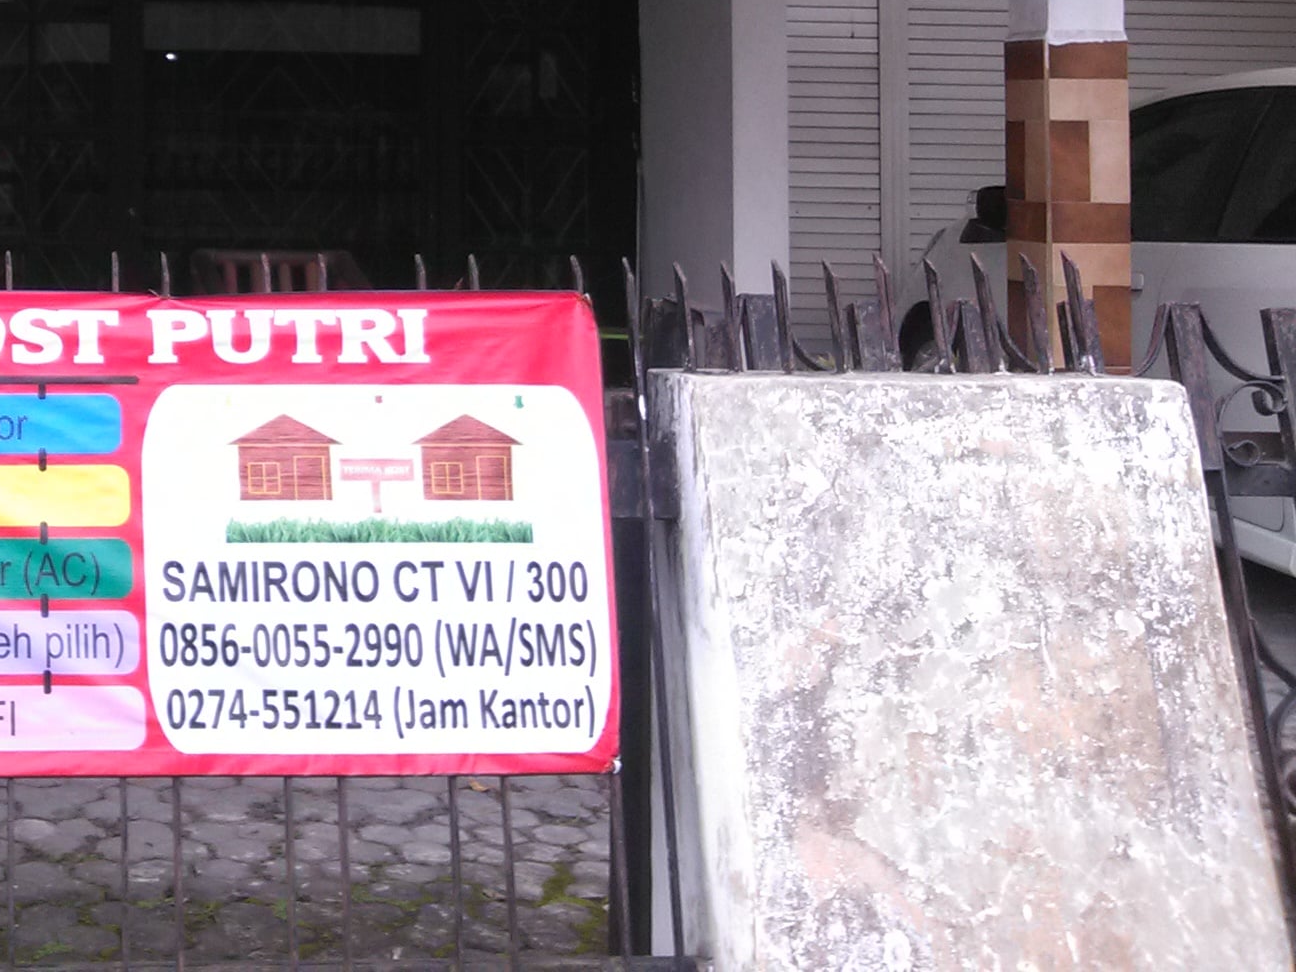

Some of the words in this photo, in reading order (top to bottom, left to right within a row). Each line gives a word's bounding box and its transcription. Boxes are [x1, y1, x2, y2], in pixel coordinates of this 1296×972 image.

[147, 308, 431, 365] PUTRI
[23, 552, 101, 596] (AC)
[162, 560, 380, 603] SAMIRONO
[393, 560, 445, 603] CT
[456, 560, 494, 602] VI
[506, 559, 515, 603] /
[527, 560, 588, 603] 300
[46, 623, 125, 668] pilih)
[159, 622, 423, 668] 0856-0055-2990
[435, 617, 598, 678] (WA/SMS)
[166, 689, 383, 730] 0274-551214
[394, 686, 469, 739] (Jam
[480, 685, 596, 738] Kantor)
